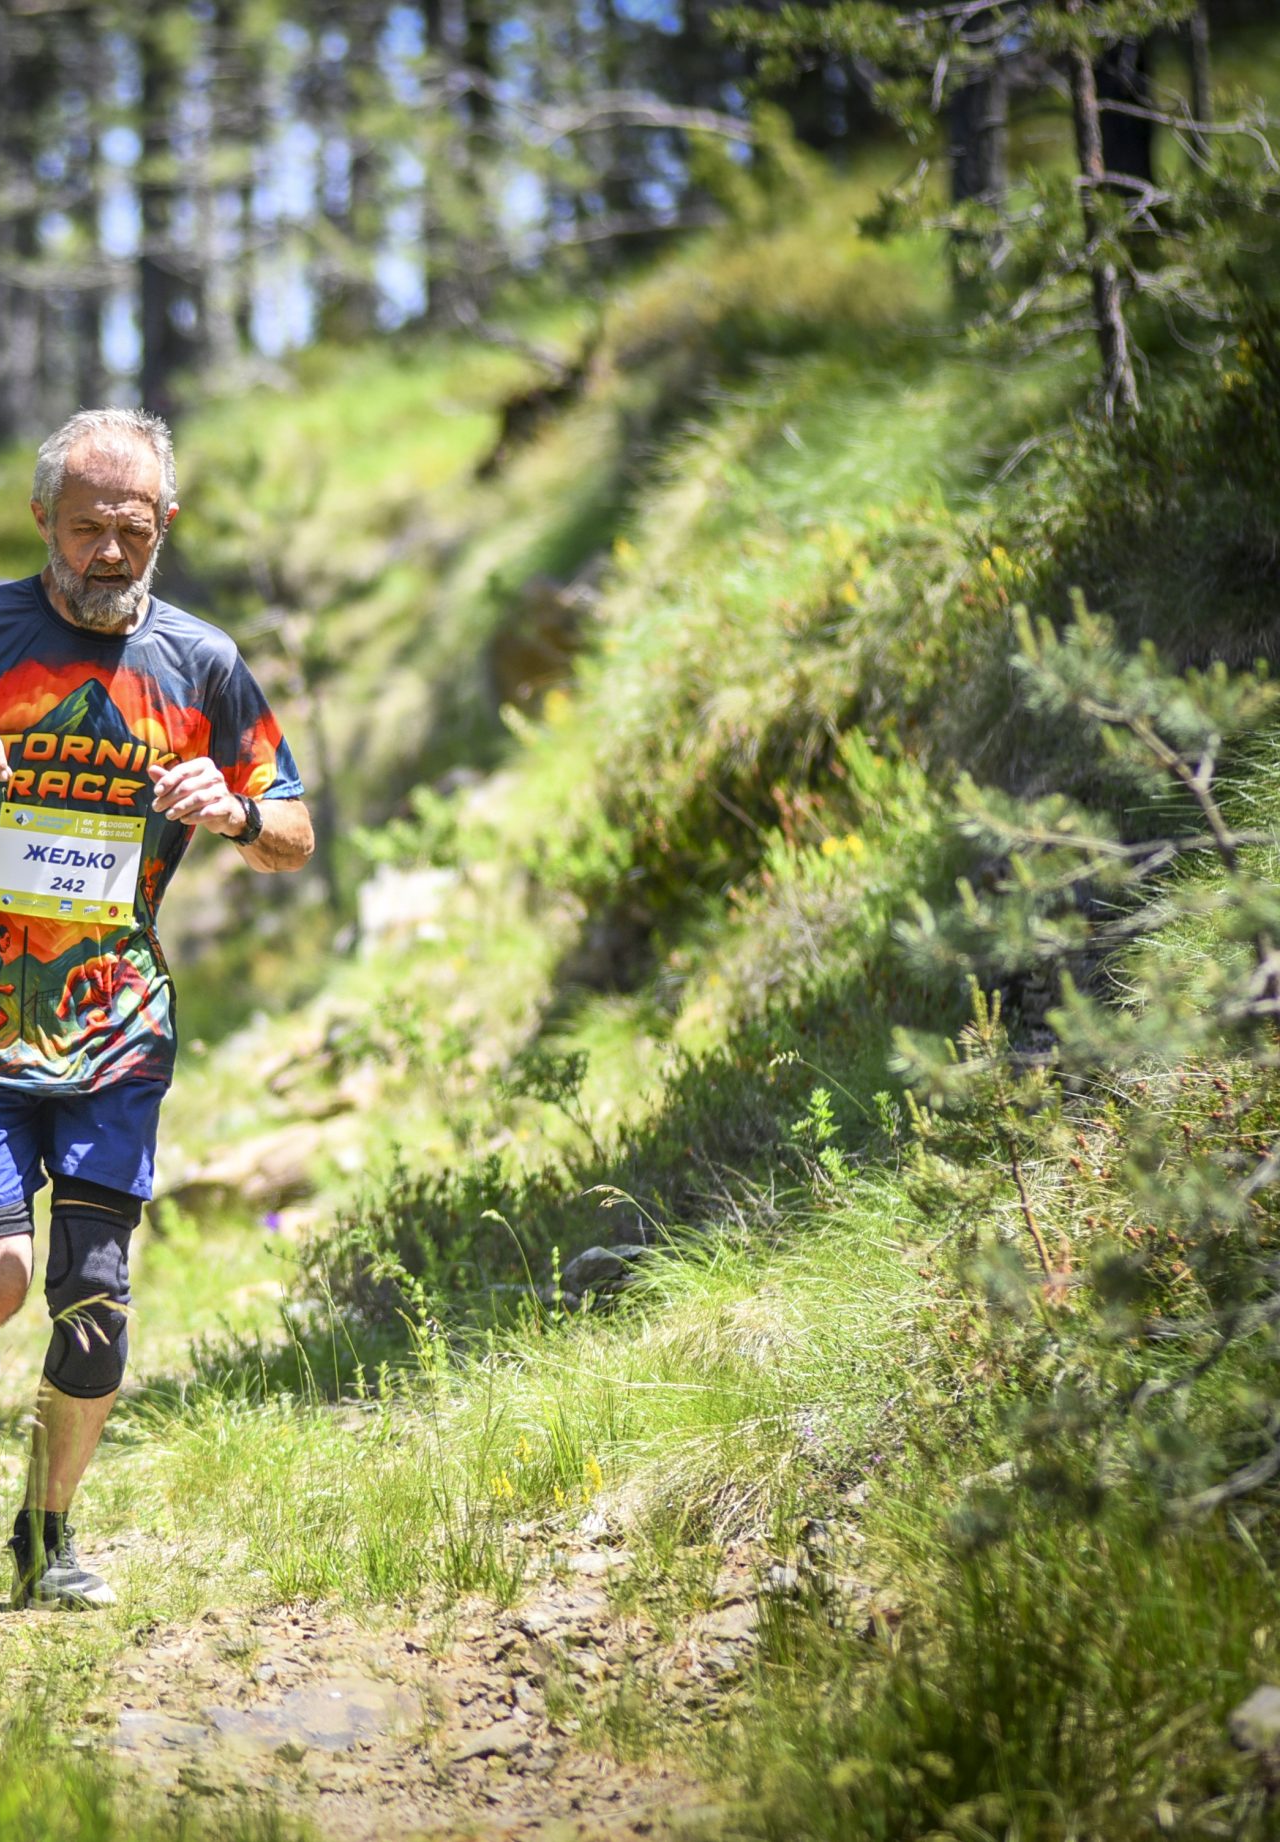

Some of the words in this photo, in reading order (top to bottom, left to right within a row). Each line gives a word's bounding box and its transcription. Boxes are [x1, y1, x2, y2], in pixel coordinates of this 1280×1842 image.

[0, 732, 181, 773] TORNIK
[6, 769, 146, 806] RACE
[80, 827, 93, 835] 15K
[97, 829, 114, 837] KIDS
[82, 818, 94, 826] 6K
[98, 821, 134, 830] PLOGGING
[22, 843, 116, 870] ЖЕЉКО
[50, 876, 86, 893] 242
